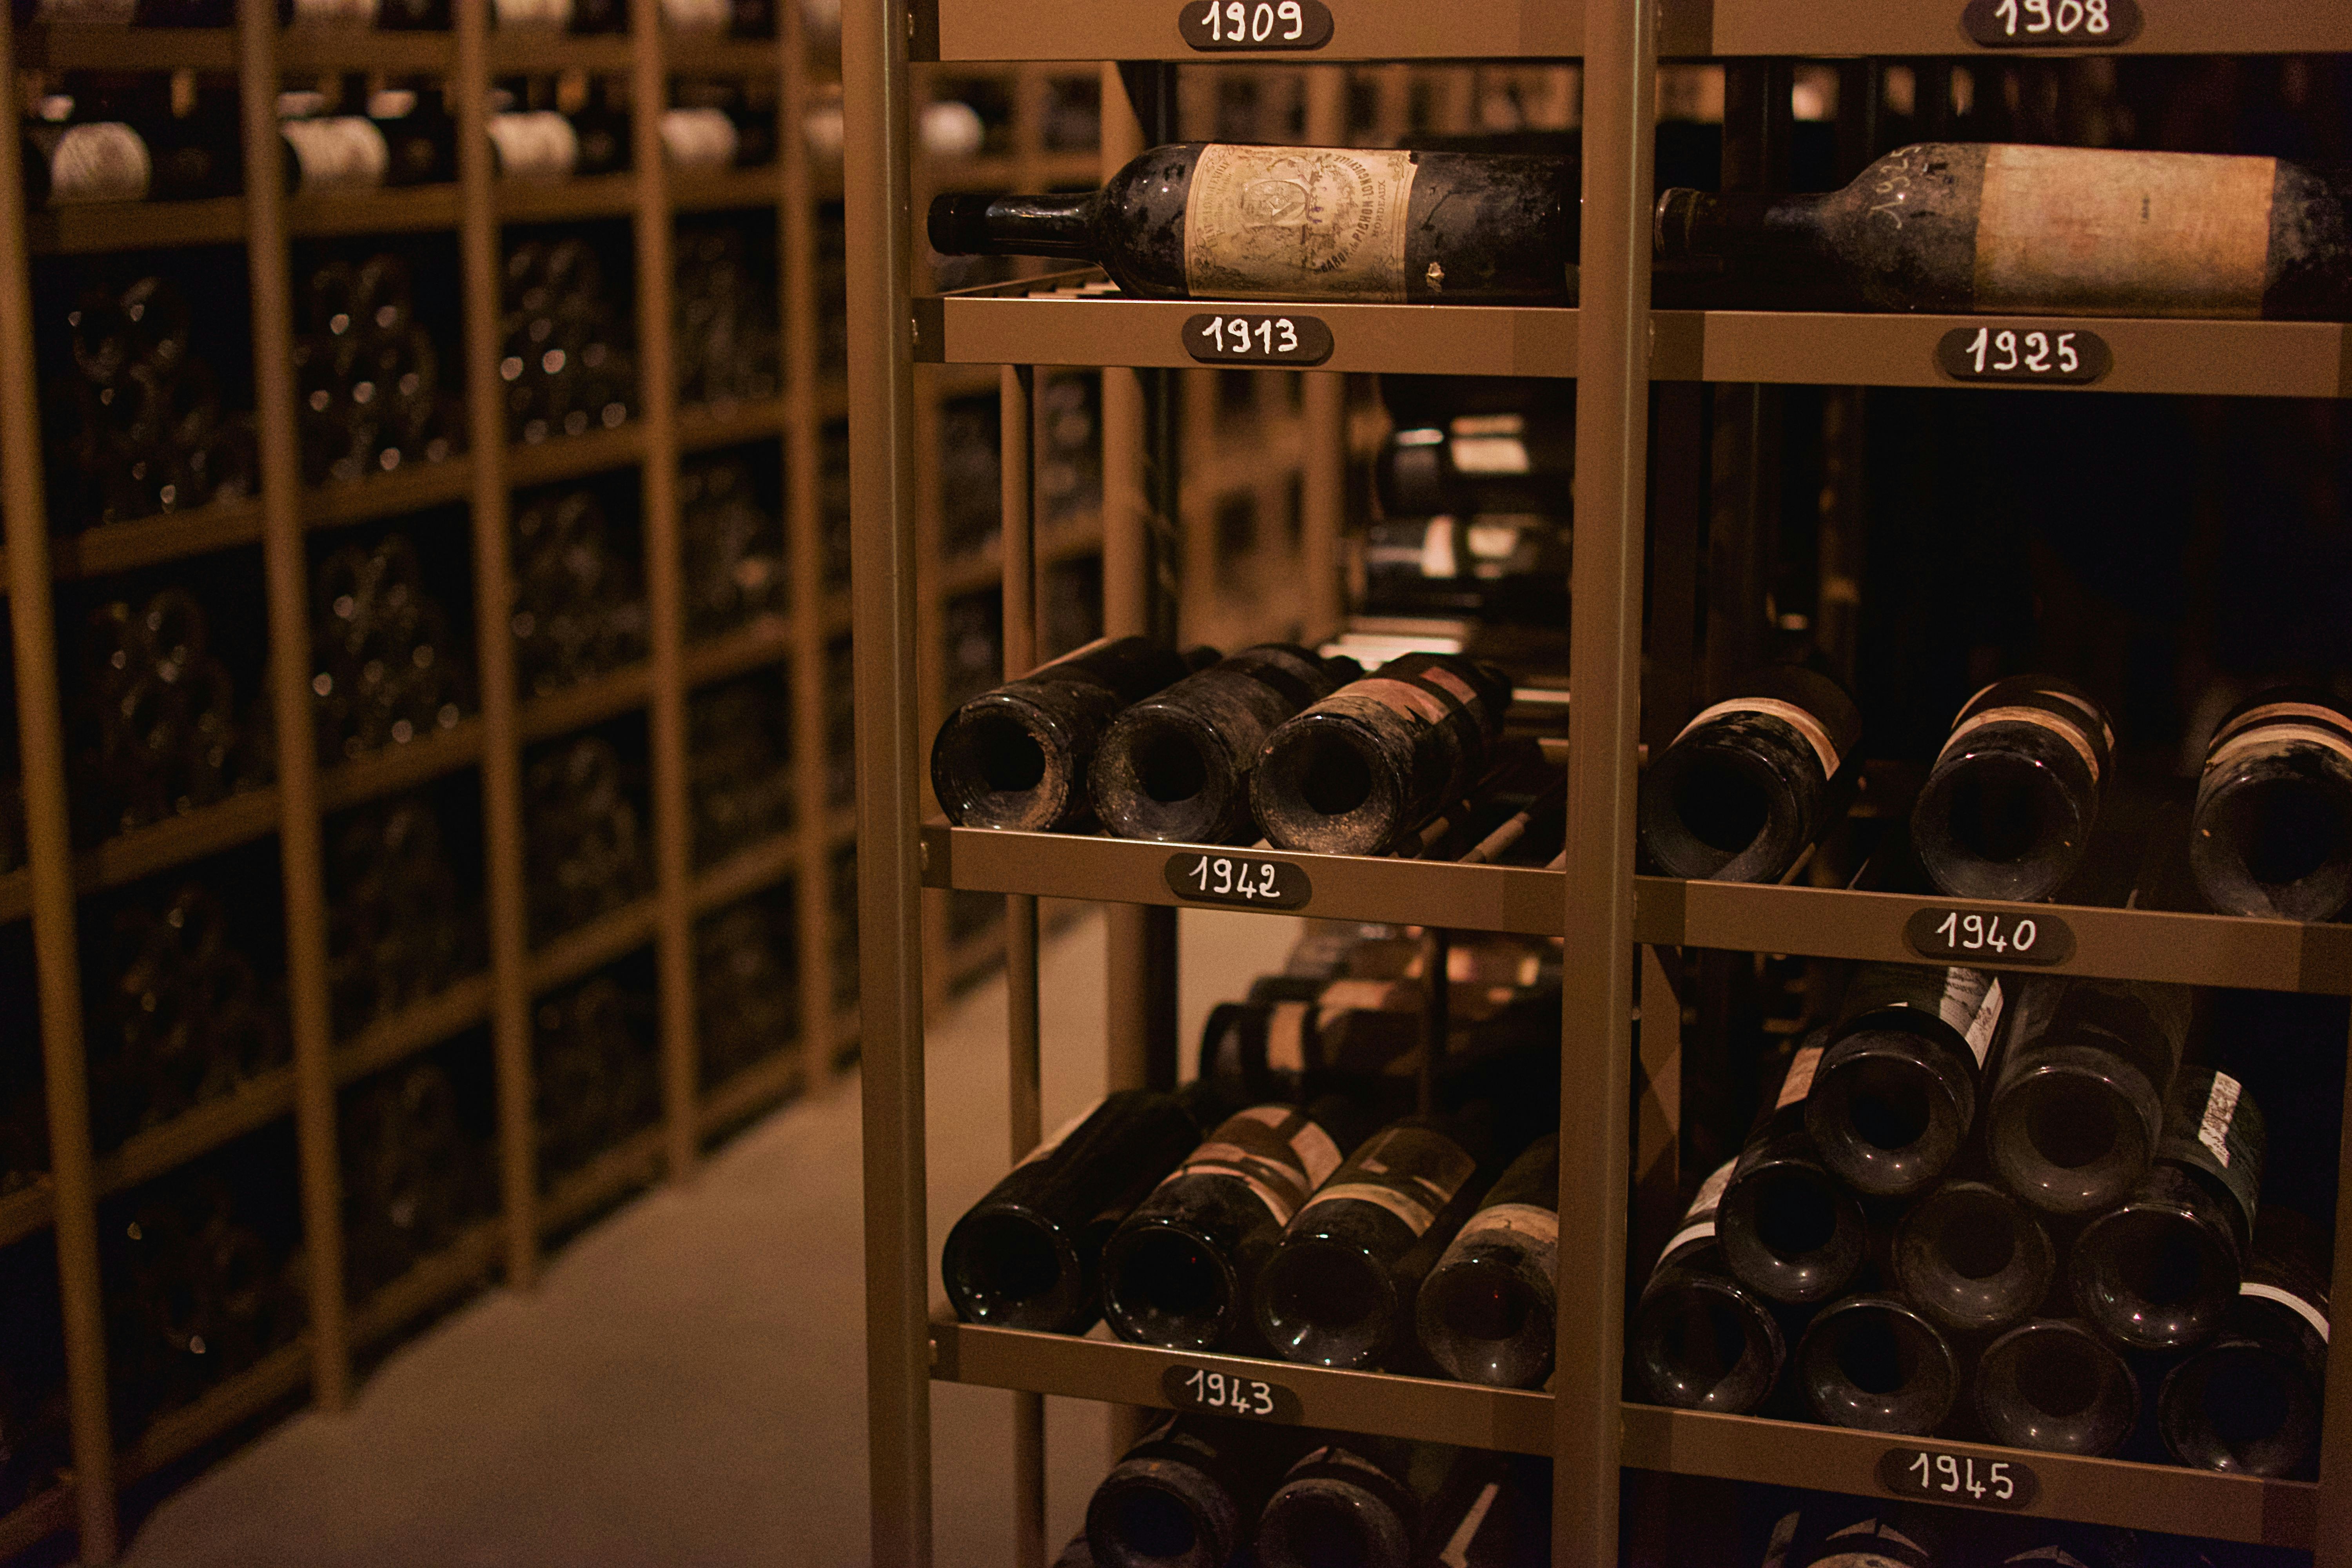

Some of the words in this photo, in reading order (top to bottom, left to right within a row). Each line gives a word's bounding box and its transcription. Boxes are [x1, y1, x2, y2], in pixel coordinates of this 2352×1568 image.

[1201, 0, 1303, 42] 1909
[1995, 0, 2109, 34] 1908
[1201, 316, 1298, 354] 1913
[1965, 327, 2078, 372] 1925
[1189, 855, 1281, 899] 1942
[1936, 912, 2036, 953] 1940
[1184, 1370, 1273, 1414] 1943
[1909, 1453, 2013, 1499] 1945
